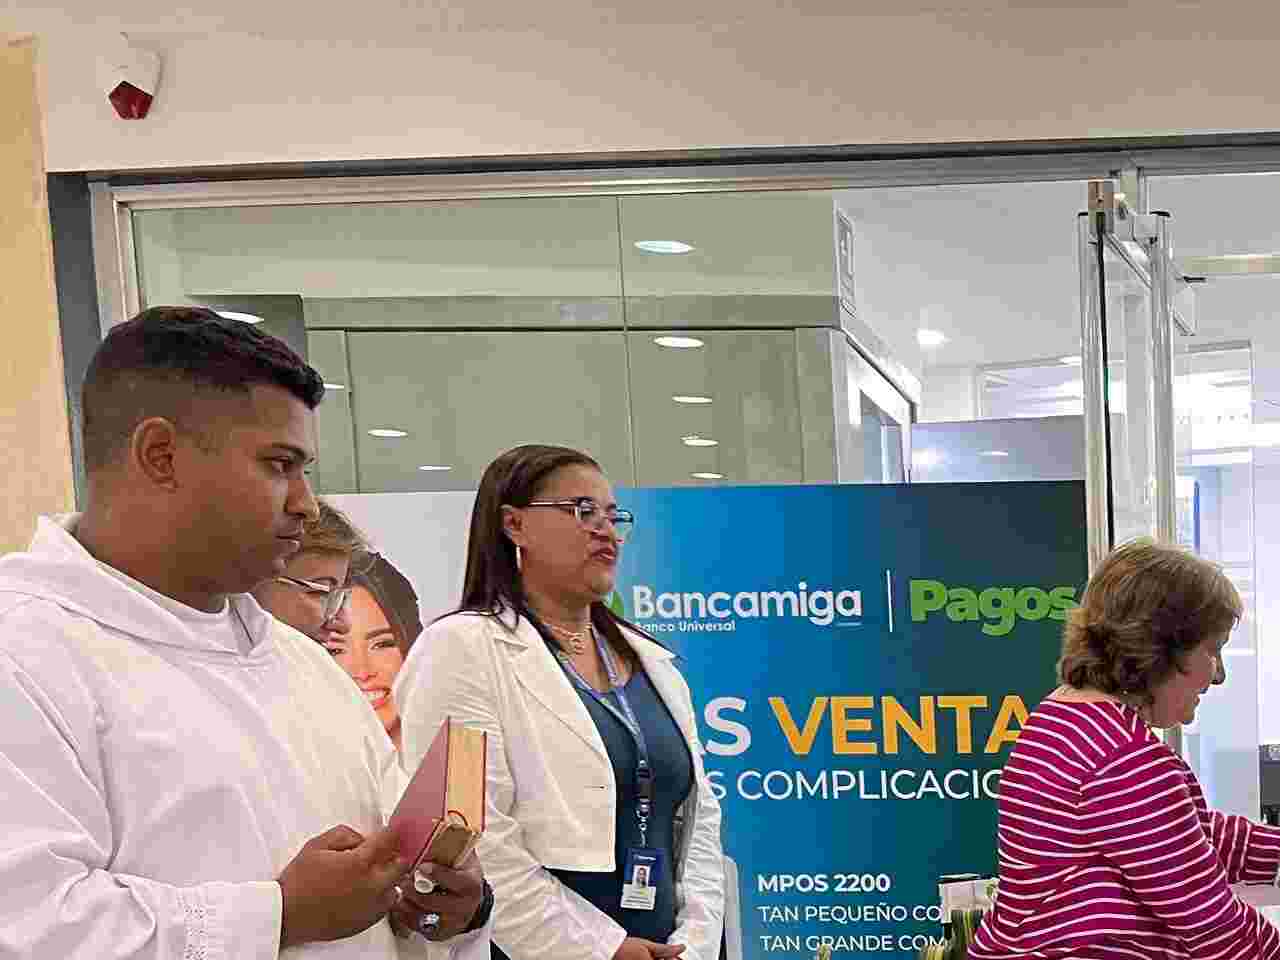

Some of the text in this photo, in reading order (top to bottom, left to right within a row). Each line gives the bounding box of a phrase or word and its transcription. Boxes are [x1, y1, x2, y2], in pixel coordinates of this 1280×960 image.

[632, 581, 863, 625] Bancamiga
[909, 580, 1080, 636] Pagos
[679, 620, 736, 633] Universal
[757, 873, 891, 893] MPOS 2200
[757, 906, 799, 922] TAN
[805, 901, 907, 925] PEQUEÑO
[760, 935, 799, 951] TAN
[805, 935, 893, 951] GRANDE
